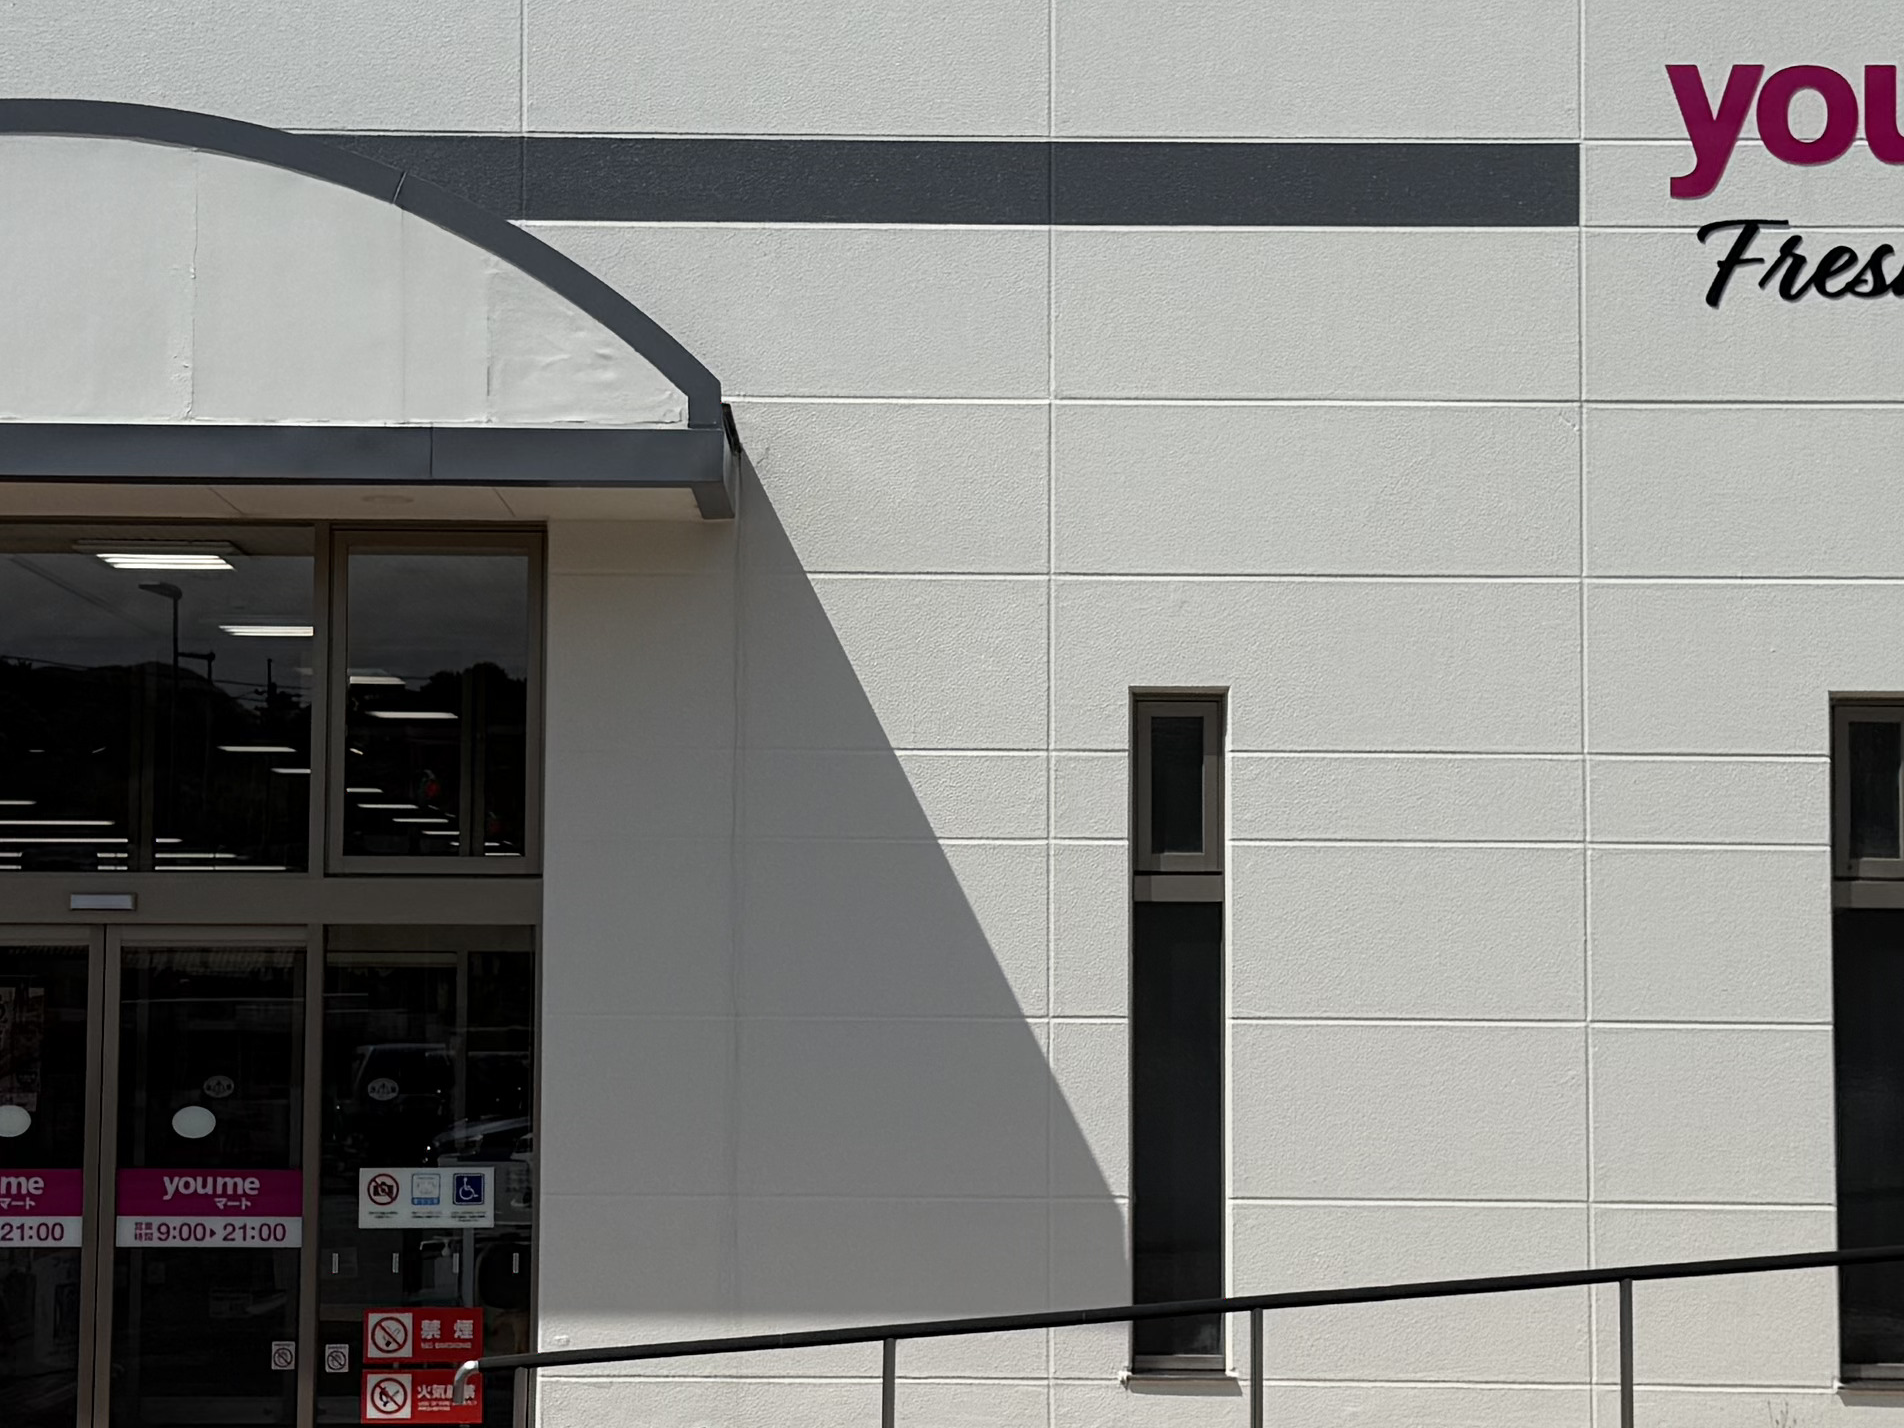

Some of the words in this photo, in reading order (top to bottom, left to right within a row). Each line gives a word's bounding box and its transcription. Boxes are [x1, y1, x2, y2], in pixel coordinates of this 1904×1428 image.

[162, 1175, 260, 1200] youme
[213, 1197, 252, 1210] マート
[0, 1223, 64, 1241] 21:00
[156, 1222, 206, 1241] 9:00
[222, 1222, 286, 1241] 21:00
